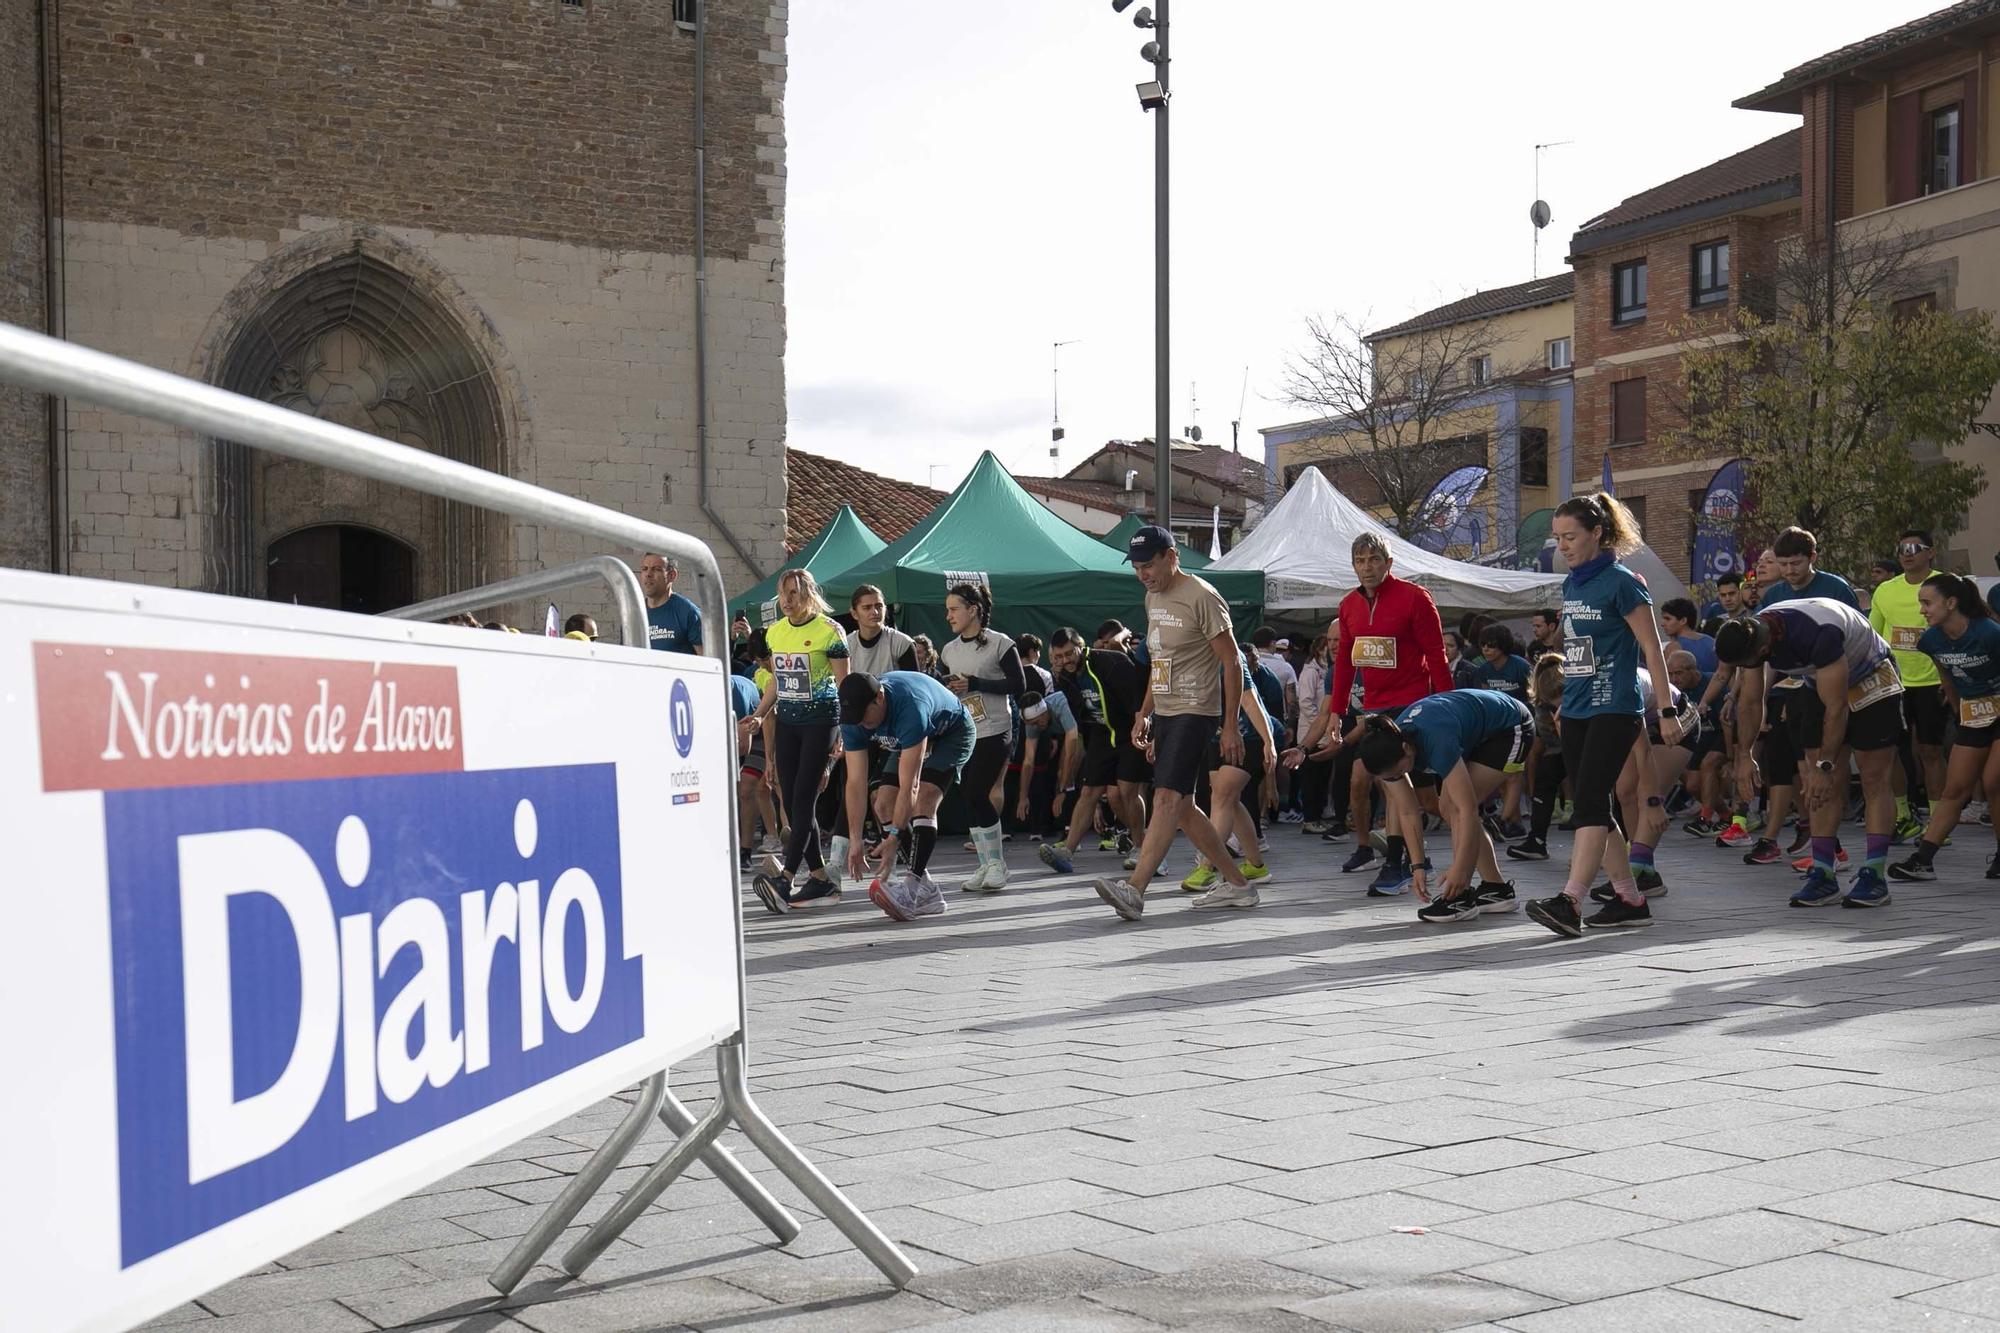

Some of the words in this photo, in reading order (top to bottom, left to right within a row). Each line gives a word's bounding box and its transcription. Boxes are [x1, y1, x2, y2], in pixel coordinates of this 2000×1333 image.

[943, 570, 981, 580] VITORIA
[1899, 632, 1916, 643] 165
[1363, 644, 1385, 657] 326
[1567, 646, 1585, 662] 1037
[783, 677, 800, 690] 749
[1859, 672, 1881, 693] 167
[101, 670, 293, 761] Noticias
[304, 678, 347, 754] de
[353, 661, 455, 752] Álava
[1970, 701, 1994, 716] 548
[675, 701, 689, 736] n
[671, 766, 699, 789] noticias
[177, 798, 607, 1185] Diario
